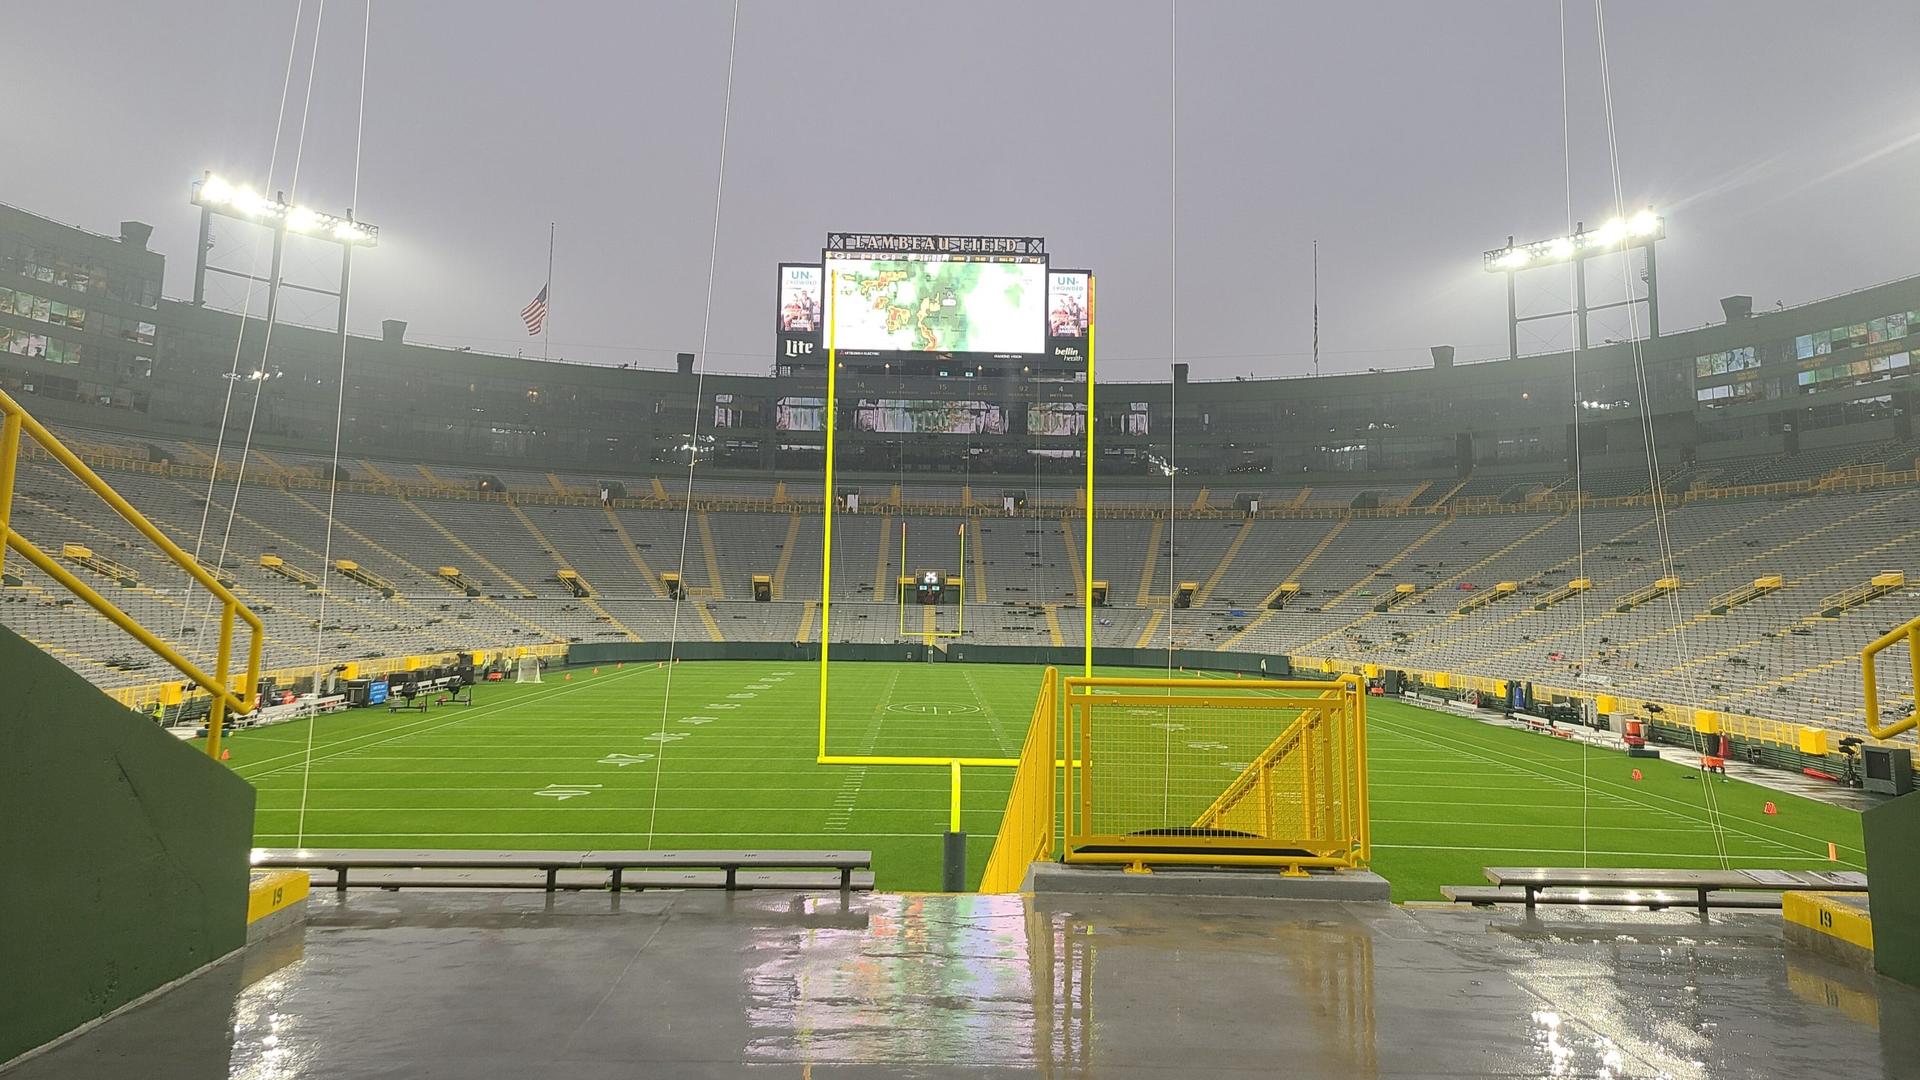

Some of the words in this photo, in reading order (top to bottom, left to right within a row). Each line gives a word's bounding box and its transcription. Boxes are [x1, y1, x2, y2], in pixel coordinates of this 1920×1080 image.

[855, 235, 949, 250] LAMBEAU
[960, 237, 1017, 252] FIELD
[791, 271, 813, 279] UN-
[1057, 276, 1080, 285] UN-
[785, 339, 814, 357] Lite
[1054, 346, 1079, 356] bellin
[1063, 354, 1084, 362] health
[272, 887, 283, 907] 19
[1820, 908, 1832, 928] 19
